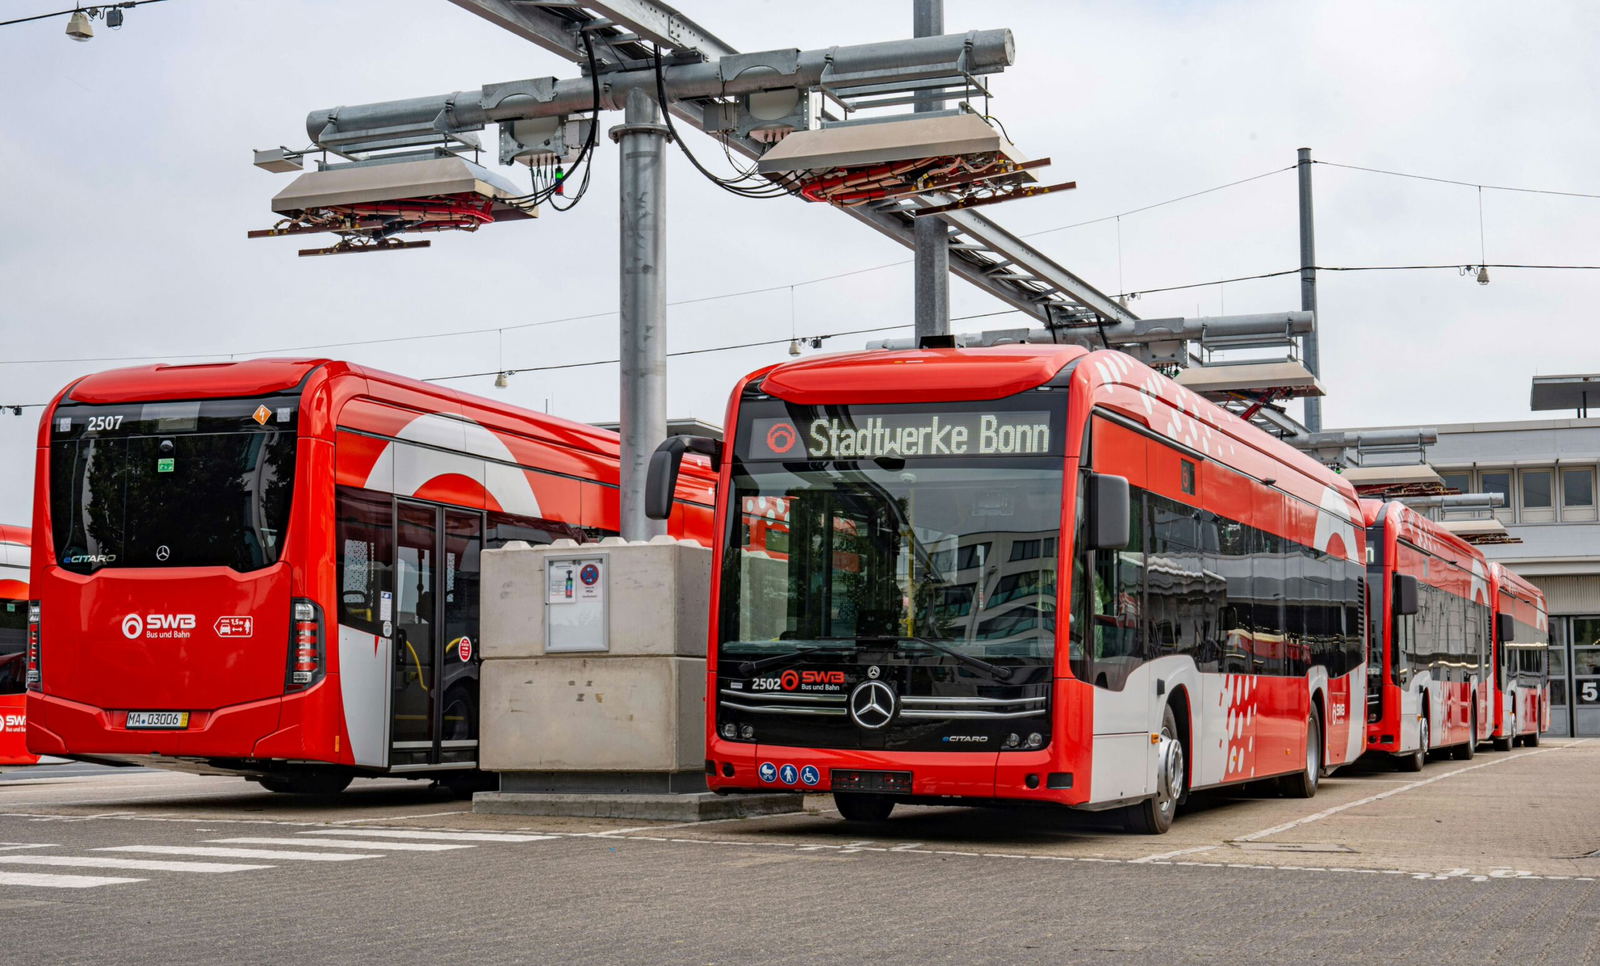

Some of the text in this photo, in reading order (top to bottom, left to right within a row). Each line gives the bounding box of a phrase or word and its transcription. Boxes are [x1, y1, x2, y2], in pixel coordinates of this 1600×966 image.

[88, 416, 123, 431] 2507
[809, 415, 1049, 456] Stadtwerke Bonn
[64, 555, 116, 563] eCITARO
[146, 614, 196, 629] SWB
[802, 671, 845, 683] SWB
[752, 678, 781, 690] 2502
[1582, 682, 1598, 701] 5
[6, 715, 26, 726] SW
[147, 713, 179, 725] 03006
